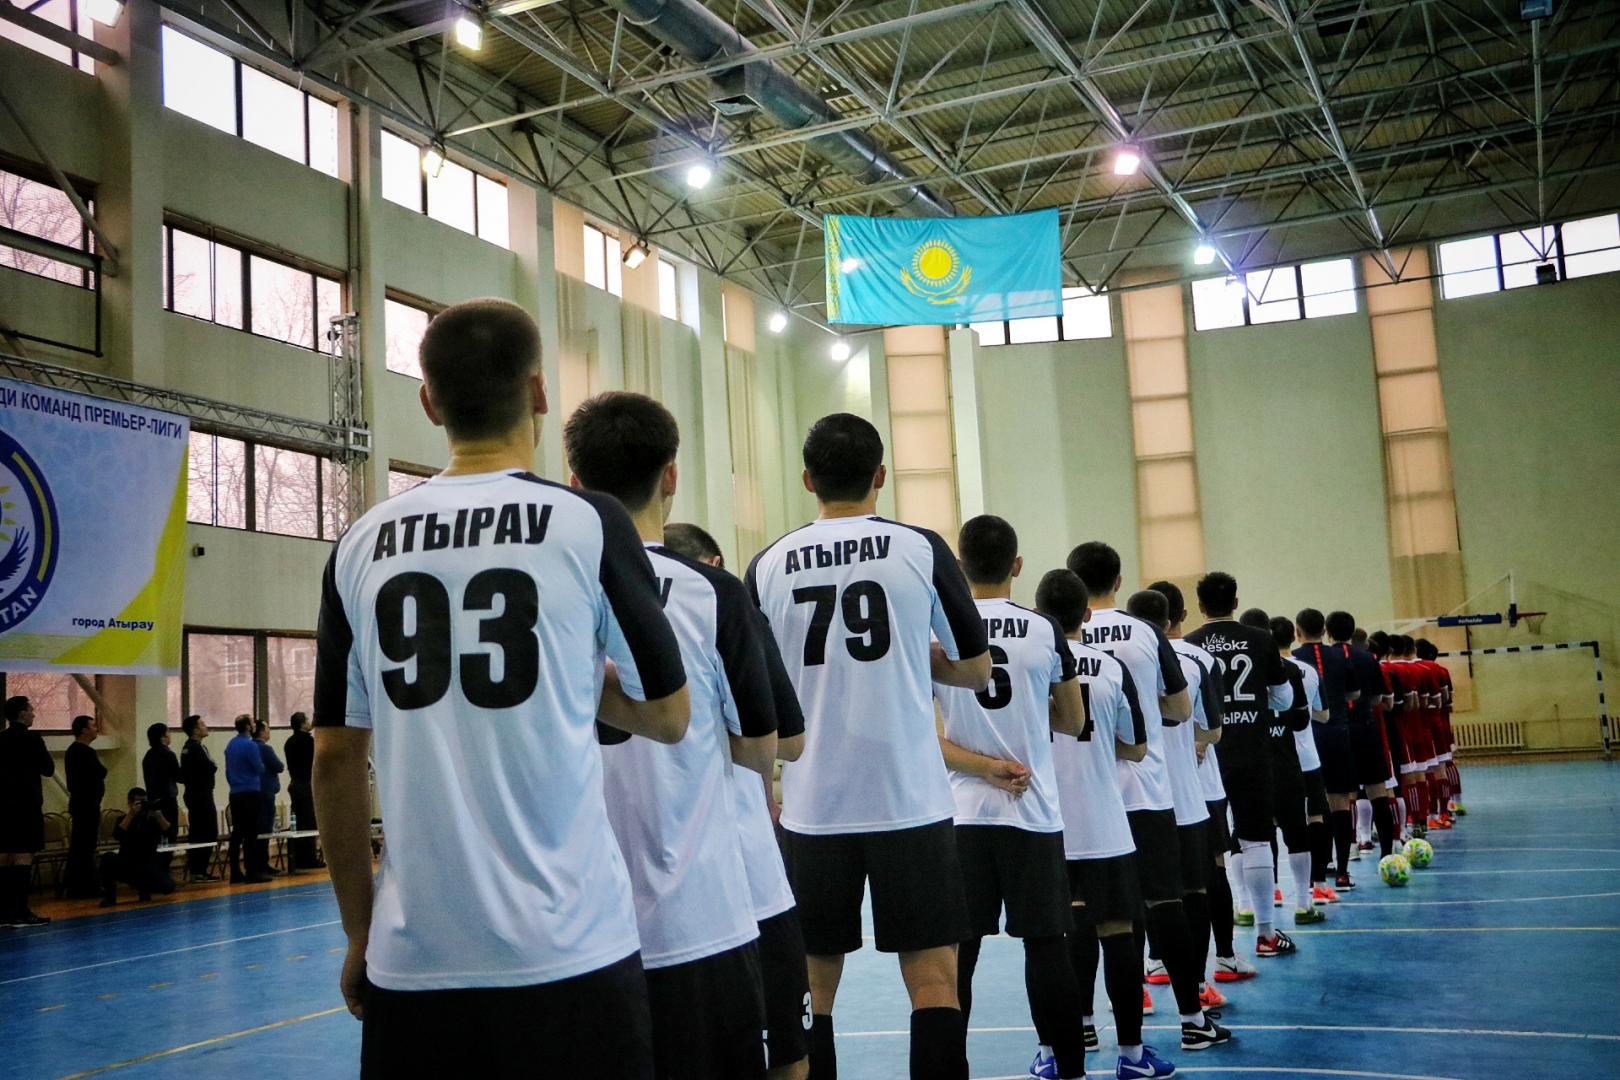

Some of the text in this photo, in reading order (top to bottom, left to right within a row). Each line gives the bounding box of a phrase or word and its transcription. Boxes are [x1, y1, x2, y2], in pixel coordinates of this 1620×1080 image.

[21, 391, 82, 423] КОМАНД
[371, 503, 553, 563] АТЫРАУ
[784, 535, 891, 576] АТЫРАУ
[72, 617, 154, 631] город Атырау
[375, 567, 540, 711] 93
[792, 579, 891, 667] 79
[801, 991, 814, 1030] 3
